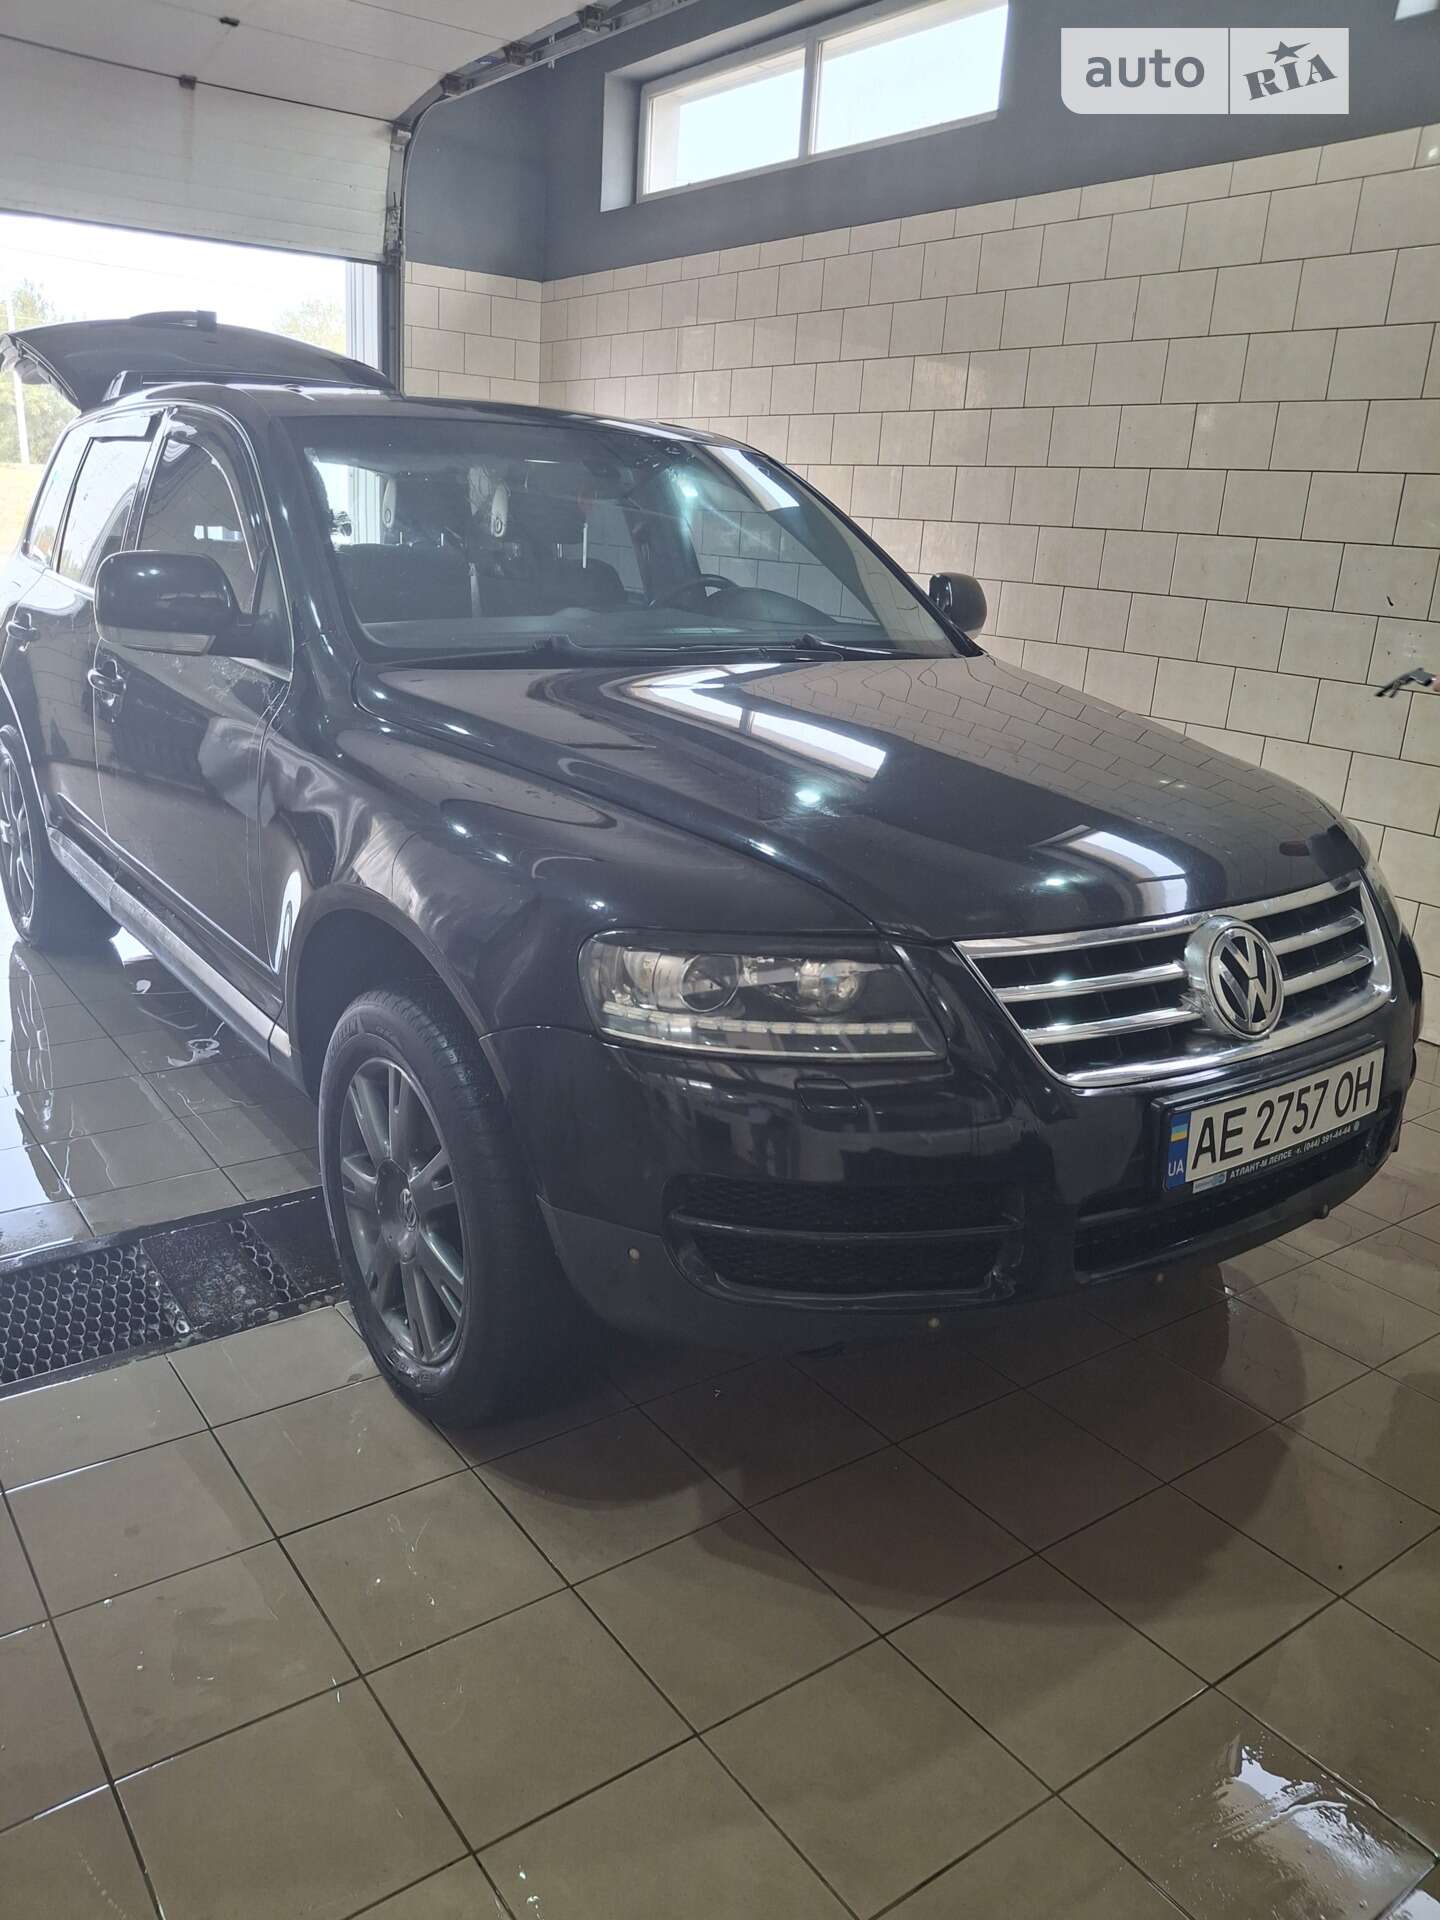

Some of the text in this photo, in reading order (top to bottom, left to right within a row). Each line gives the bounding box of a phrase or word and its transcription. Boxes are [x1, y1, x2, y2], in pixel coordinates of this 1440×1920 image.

[1191, 1060, 1374, 1170] AE 2757 OH
[1168, 1159, 1184, 1177] UA
